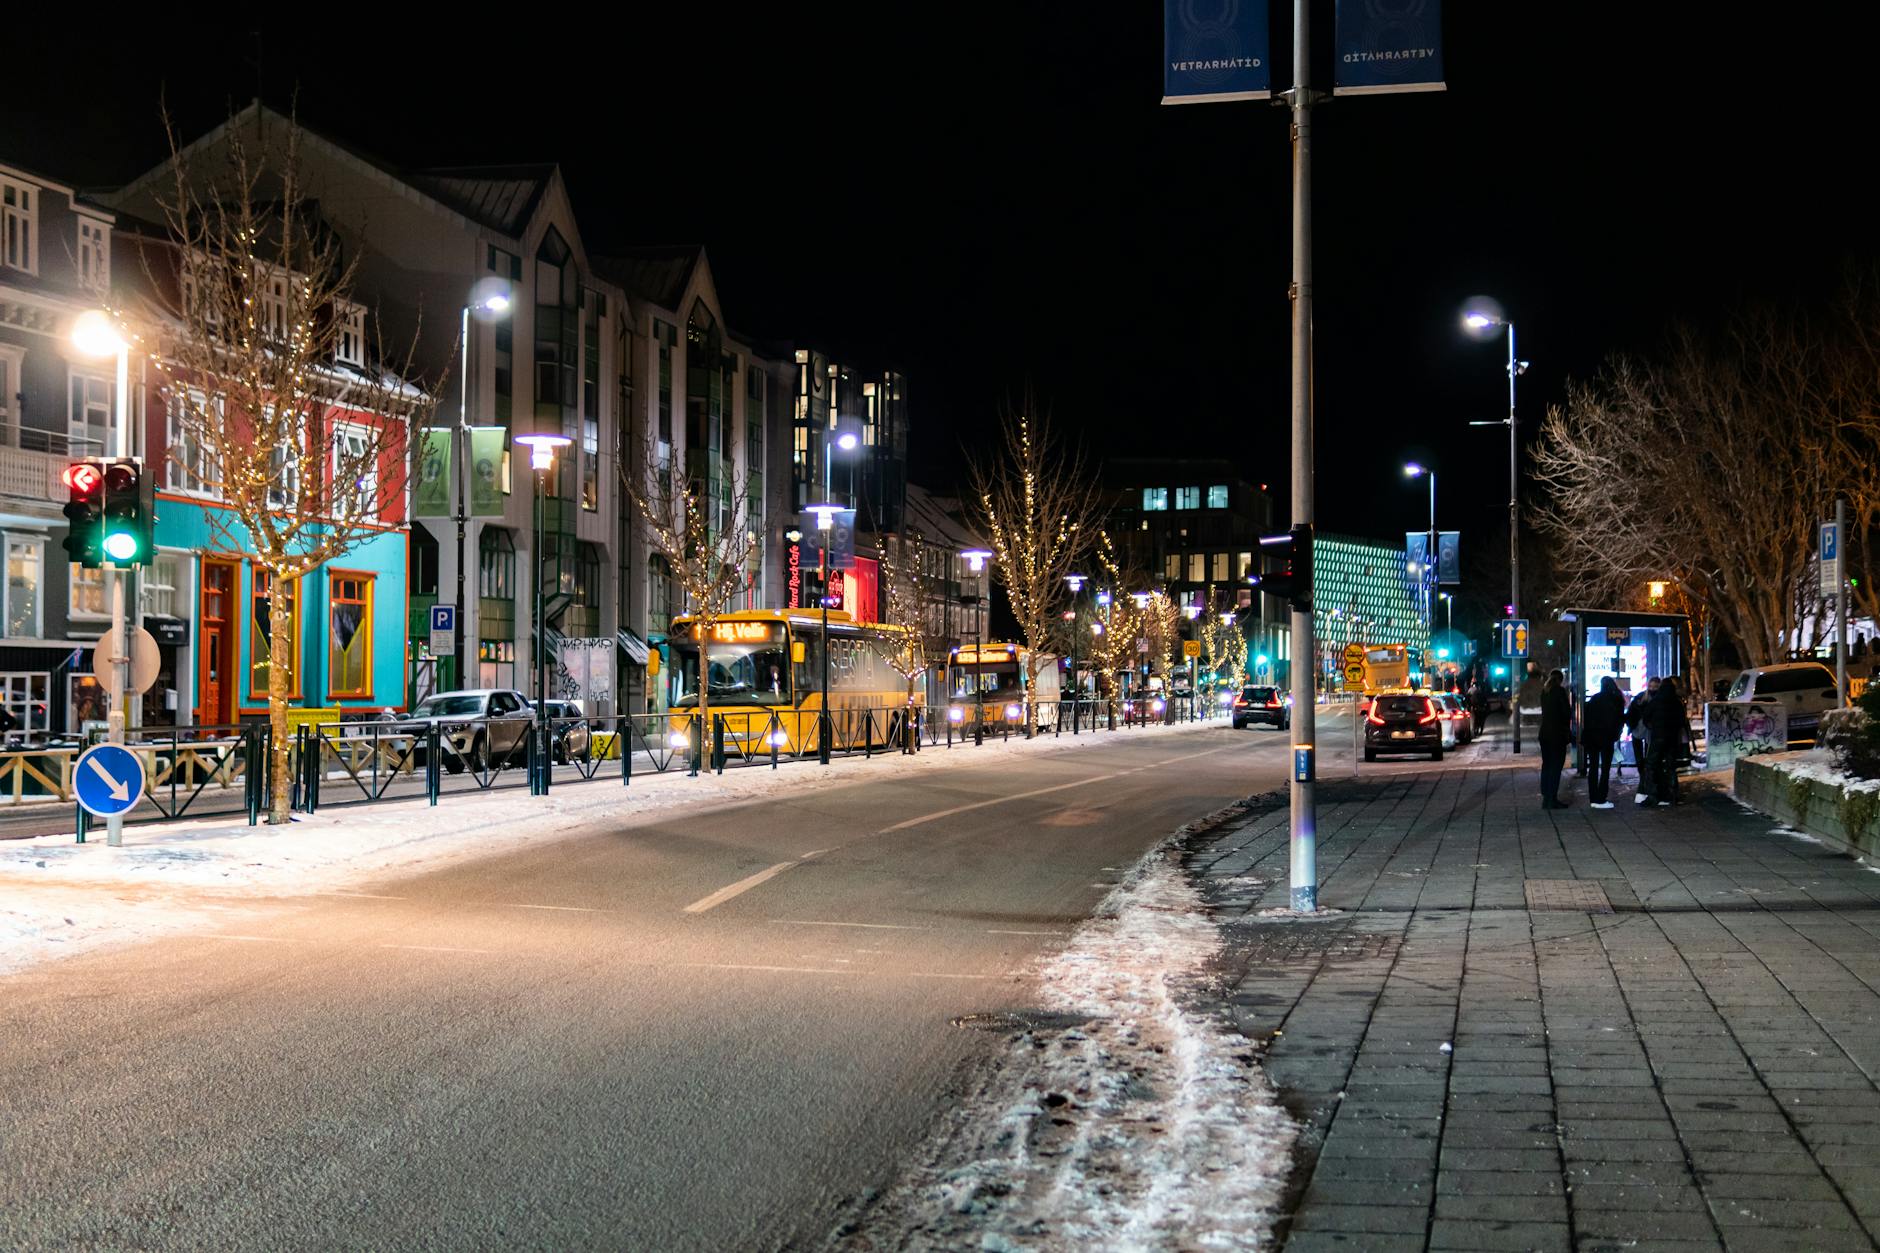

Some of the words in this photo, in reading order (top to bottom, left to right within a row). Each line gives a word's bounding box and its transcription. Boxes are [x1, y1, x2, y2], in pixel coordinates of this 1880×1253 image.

[789, 545, 801, 566] Cafe
[789, 566, 801, 588] Rock
[789, 586, 801, 609] Hard
[437, 612, 448, 626] P
